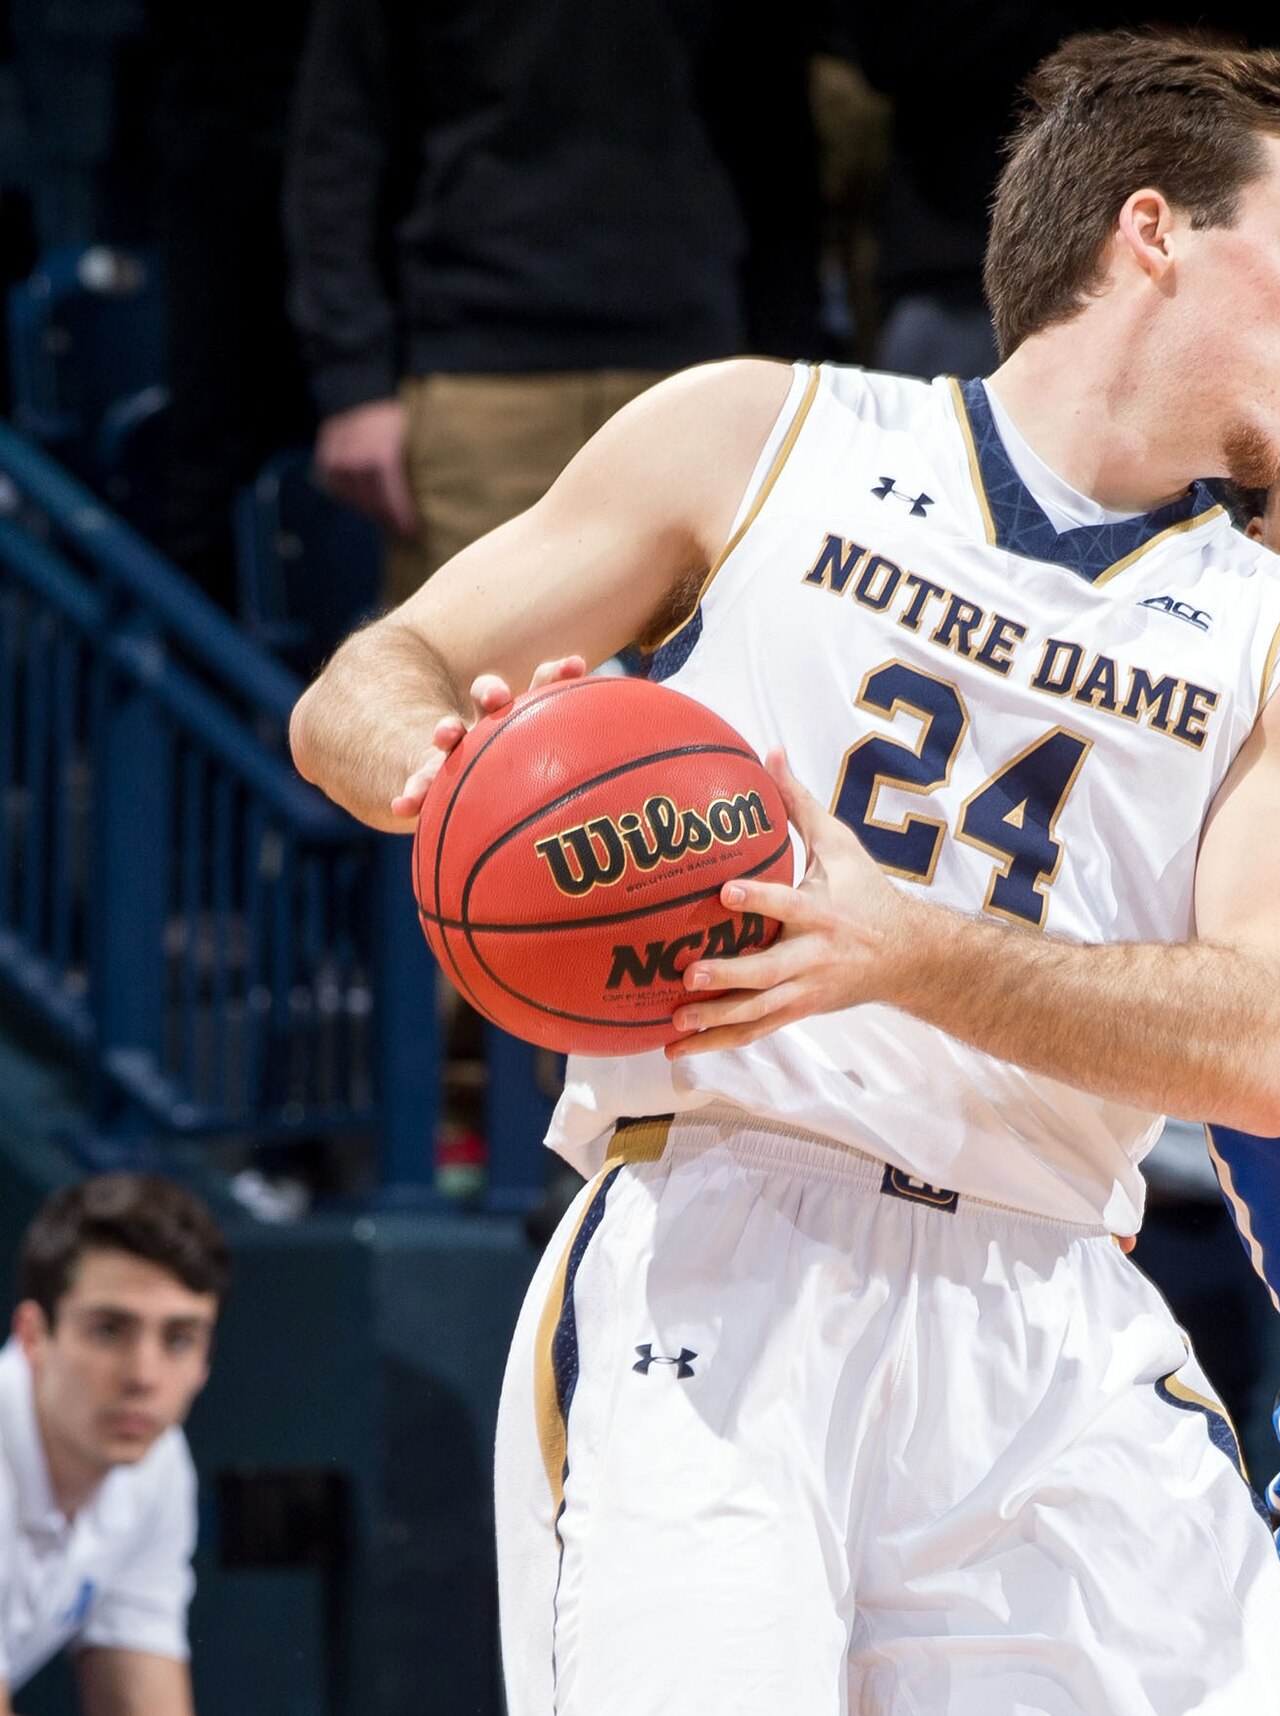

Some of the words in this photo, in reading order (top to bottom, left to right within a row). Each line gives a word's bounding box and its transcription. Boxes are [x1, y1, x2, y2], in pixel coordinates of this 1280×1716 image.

[802, 532, 1028, 677] NOTRE
[1029, 636, 1220, 753] DAME
[1135, 595, 1213, 632] ACC
[535, 790, 774, 898] Wilson
[828, 657, 1094, 929] 24
[605, 911, 765, 989] NCAA
